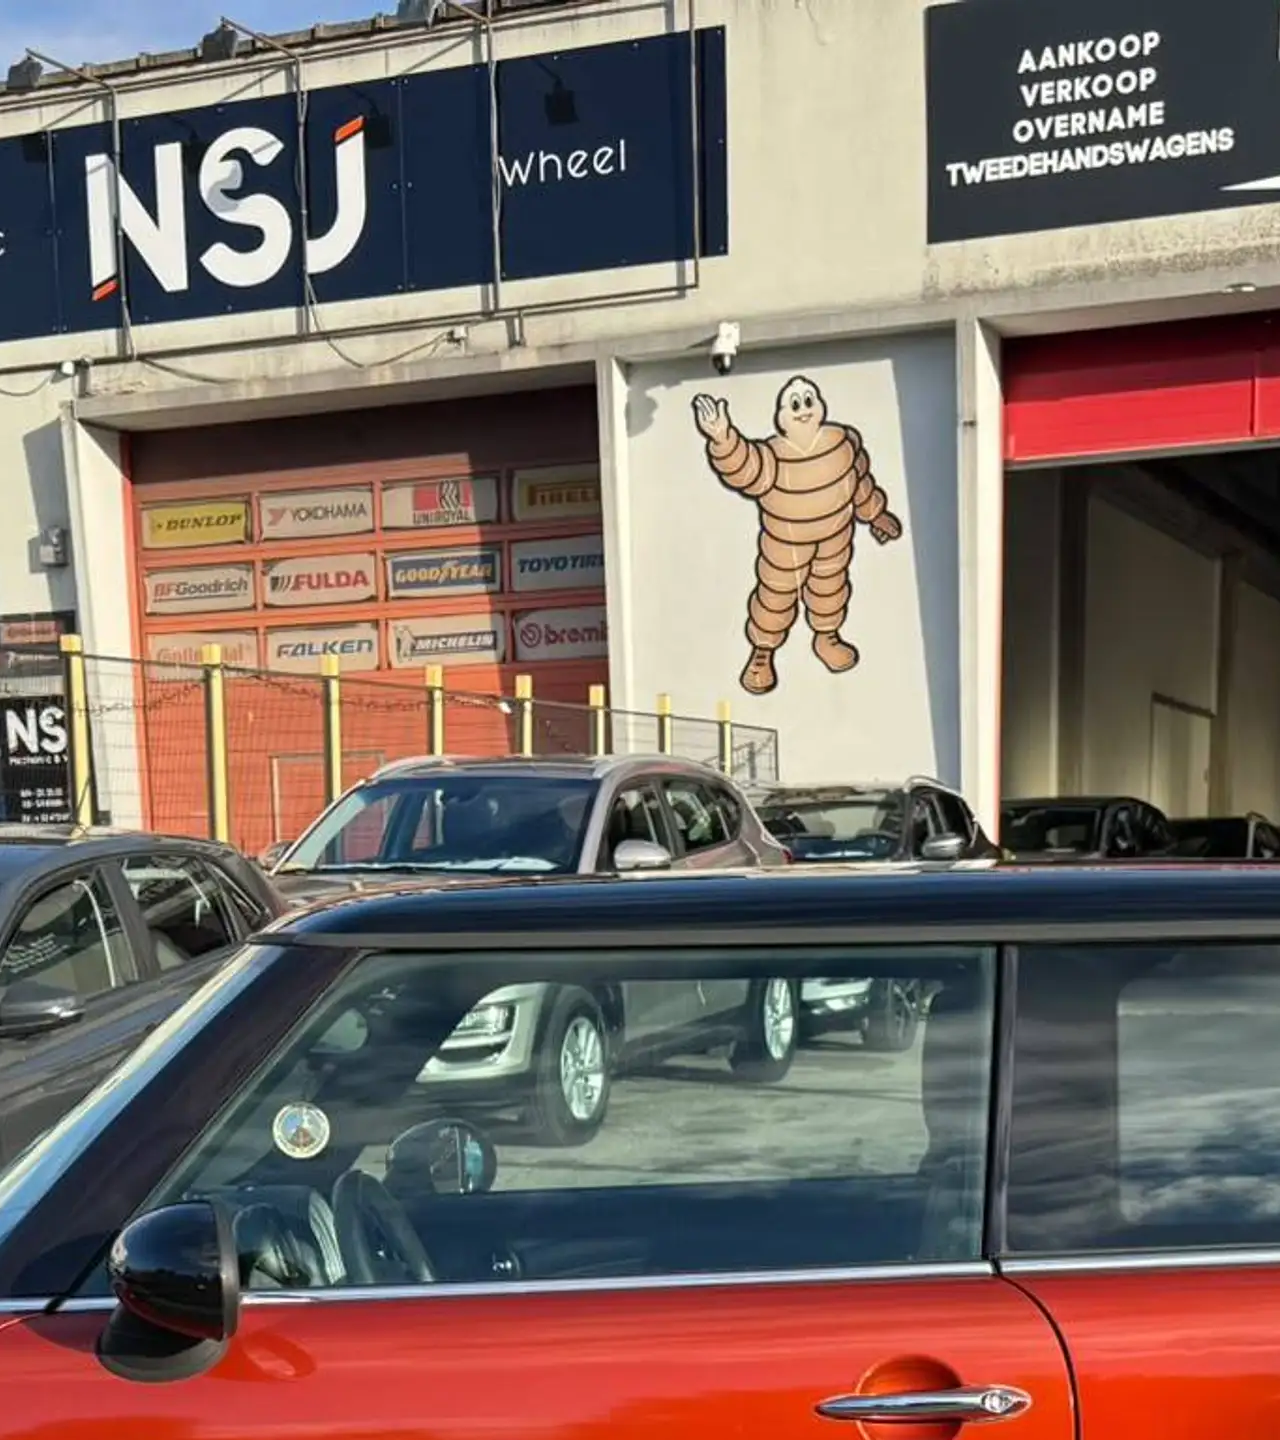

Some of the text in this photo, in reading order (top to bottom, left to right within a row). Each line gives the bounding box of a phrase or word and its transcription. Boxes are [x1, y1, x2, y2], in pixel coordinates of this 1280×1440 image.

[1018, 31, 1161, 74] AANKOOP
[1020, 67, 1157, 108] VERKOOP
[1012, 101, 1165, 143] OVERNAME
[945, 128, 1236, 187] TWEEDEHANDSWAGENS
[84, 115, 368, 301] NSJ
[166, 513, 242, 531] DUNLOP
[291, 502, 368, 523] YOKOHAMA
[413, 509, 471, 525] UNIROYAL
[153, 576, 248, 598] BFGoodrich
[291, 569, 369, 591] FULDA
[276, 639, 374, 659] FALKEN
[414, 632, 495, 651] MICHELIN
